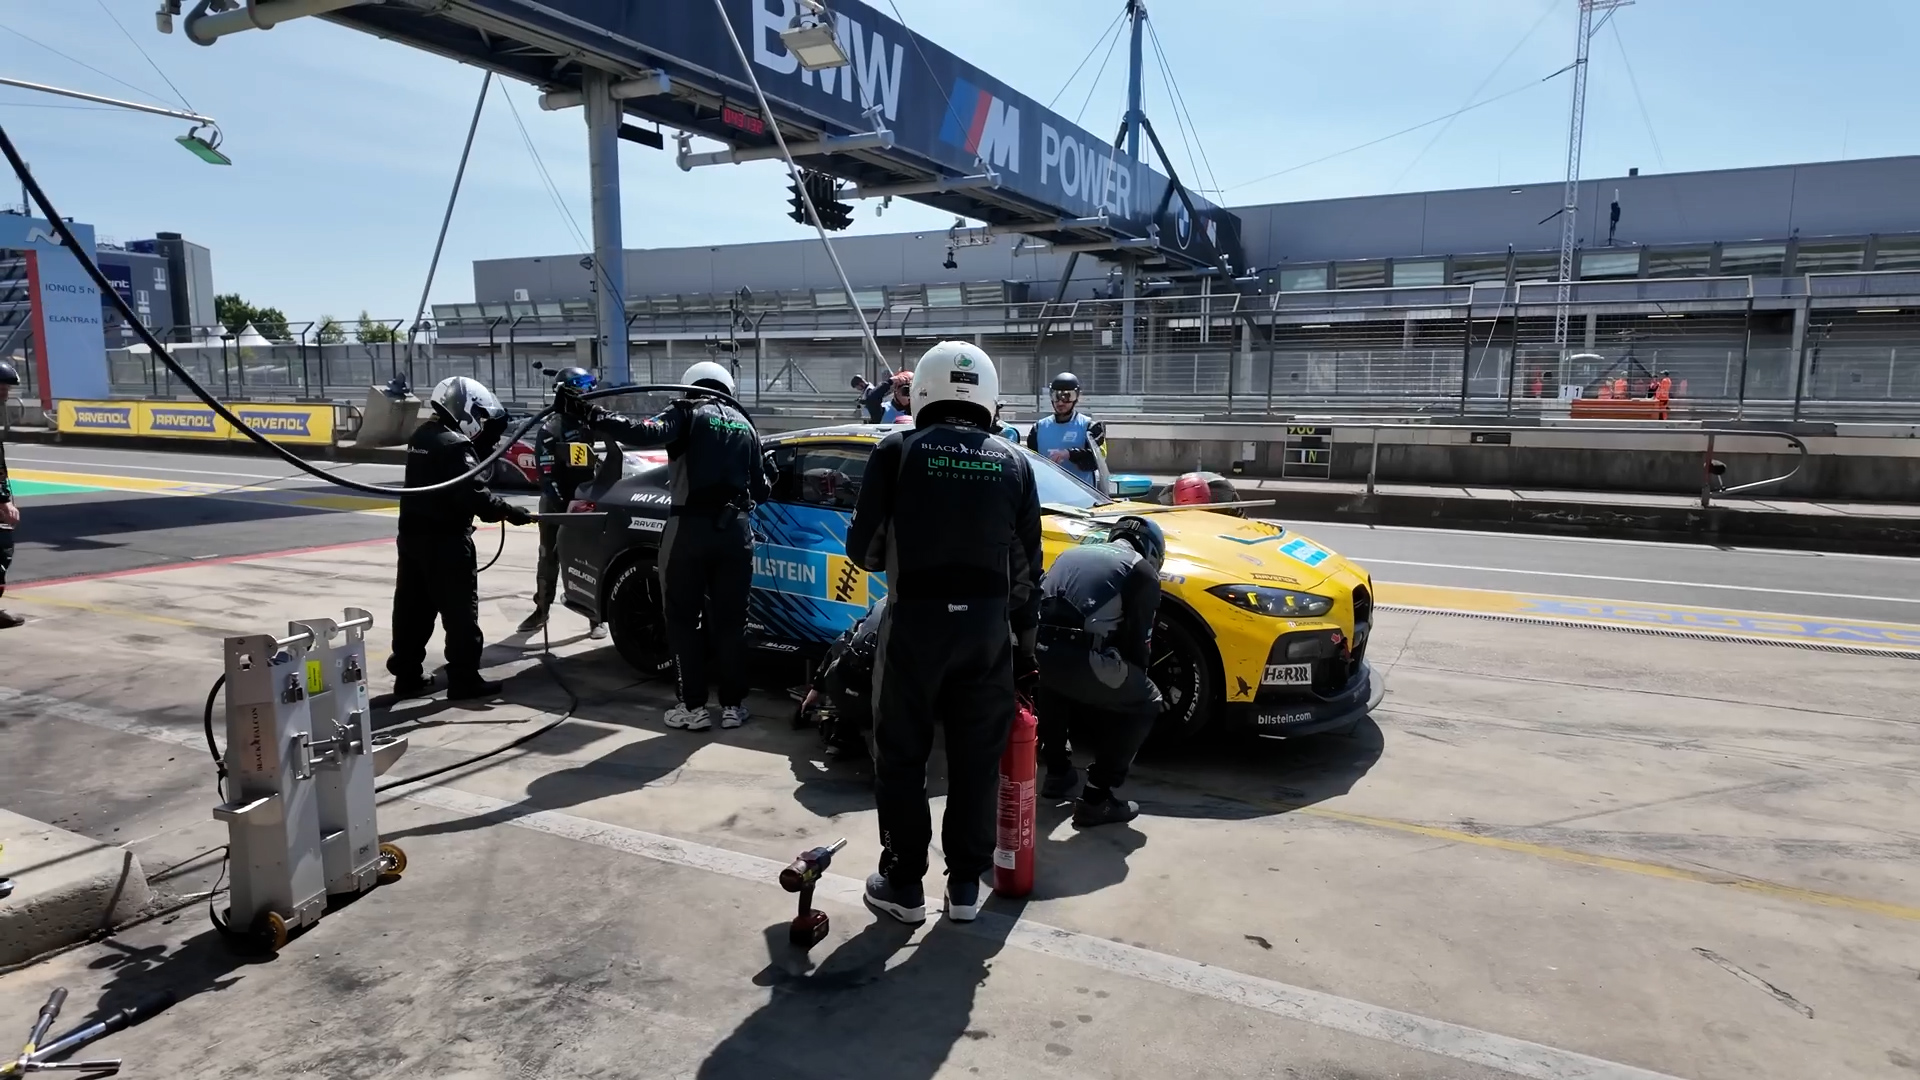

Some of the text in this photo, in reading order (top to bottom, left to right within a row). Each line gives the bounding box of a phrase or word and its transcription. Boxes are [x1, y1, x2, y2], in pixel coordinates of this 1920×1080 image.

[752, 0, 904, 121] BMW
[1041, 122, 1131, 220] POWER
[45, 283, 76, 294] IONIQ
[79, 286, 85, 294] 5
[49, 315, 89, 324] ELANTRA
[78, 411, 127, 424] RAVENOL
[156, 414, 211, 428] RAVENOL
[241, 416, 305, 431] RAVENOL
[921, 443, 1006, 459] BLACK FALCON
[952, 460, 1002, 472] LOSCH
[928, 471, 1002, 482] MOTORSPORT
[630, 493, 657, 503] WAY
[633, 520, 663, 529] RAVEN
[568, 566, 597, 585] FALKEN
[753, 556, 816, 584] ILSTEIN
[610, 566, 637, 601] FALKEN
[1264, 667, 1294, 681] H&R
[1258, 712, 1312, 724] bilstein.com
[251, 707, 263, 772] BLACK FALCON
